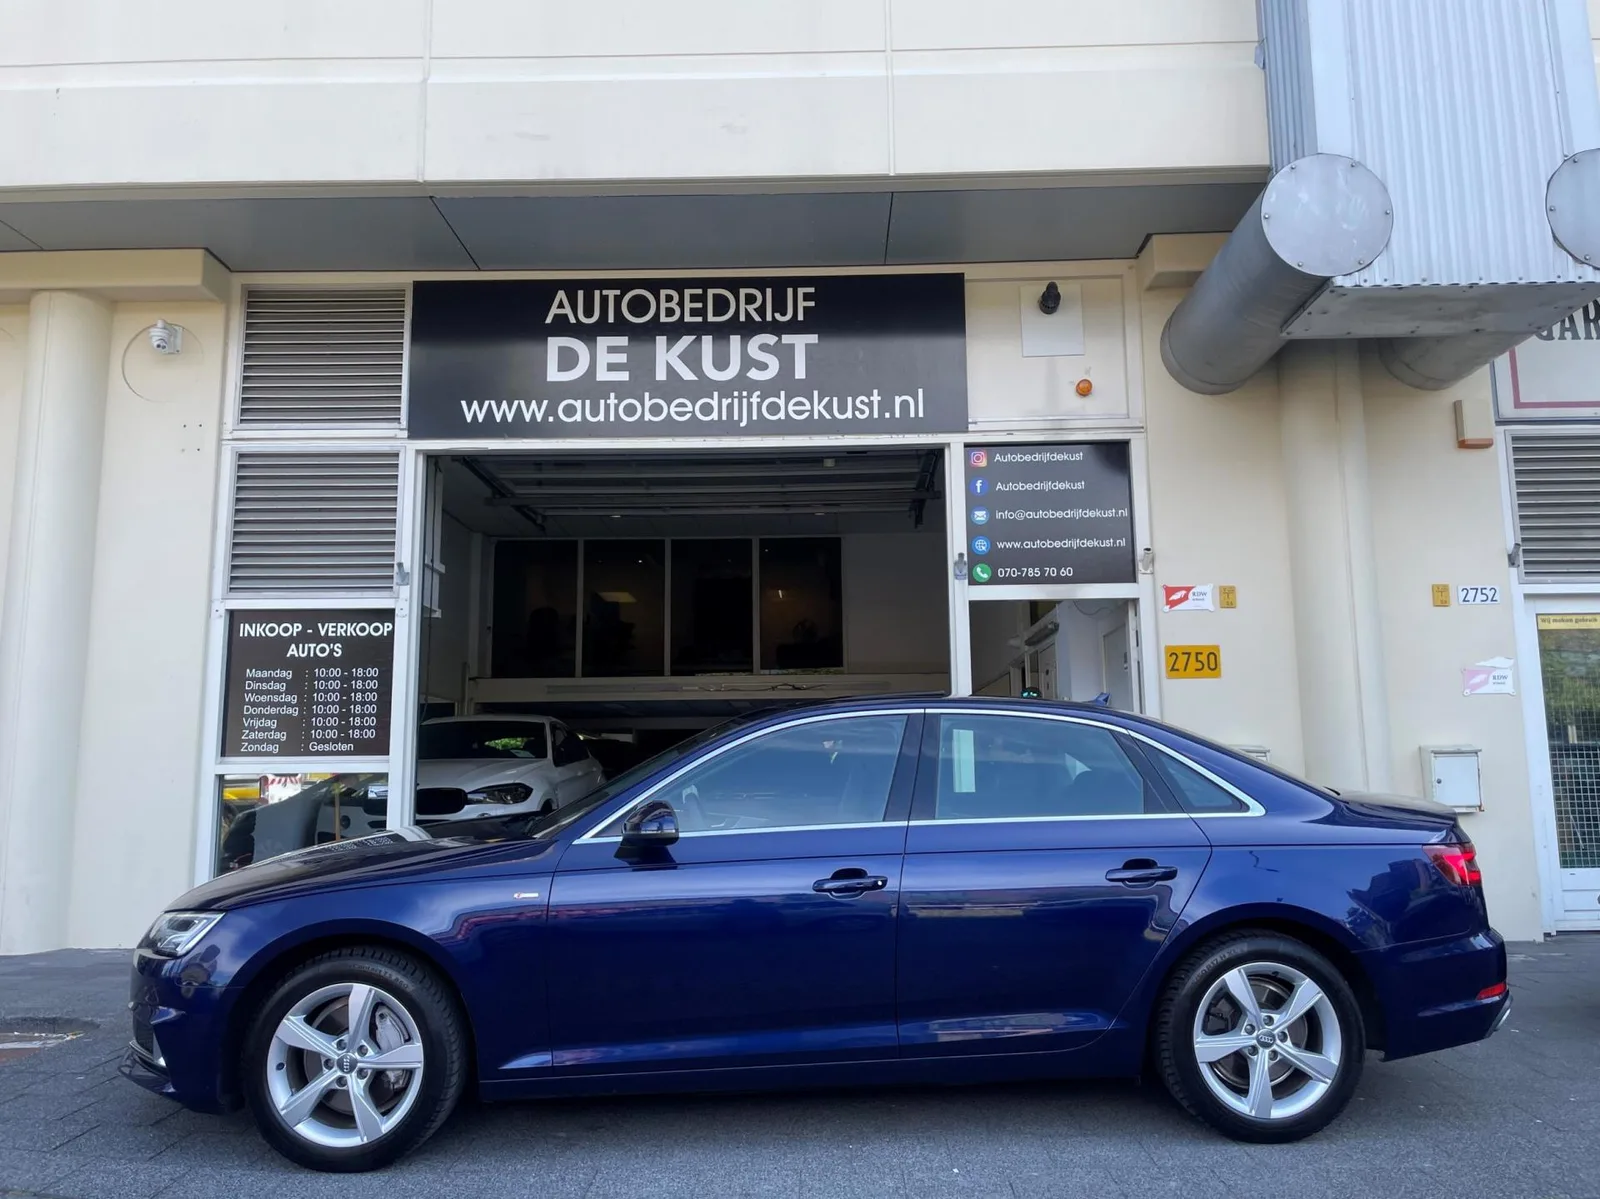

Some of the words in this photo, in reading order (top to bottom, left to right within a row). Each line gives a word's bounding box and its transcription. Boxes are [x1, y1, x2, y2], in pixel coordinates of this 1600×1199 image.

[545, 288, 815, 324] AUTOBEDRIJF
[1535, 298, 1600, 341] AR
[547, 336, 630, 382] DE
[654, 334, 819, 381] KUST
[461, 388, 924, 427] www.autobedrijfdekust.nl
[994, 452, 1083, 462] Autobedrijfdekust
[996, 481, 1084, 491] Autobedrijfdekust
[996, 508, 1127, 520] info@autobedrijfdekust.nl
[997, 538, 1125, 549] www.autobedrijfdekust.nl
[998, 568, 1040, 577] 070-785
[1044, 568, 1056, 576] 70
[1060, 567, 1073, 576] 60
[1461, 588, 1497, 602] 2752
[240, 623, 302, 637] INKOOP
[318, 623, 392, 636] VERKOOP
[287, 643, 342, 657] AUTO'S
[1169, 652, 1217, 672] 2750
[246, 669, 292, 679] Maandag
[314, 668, 341, 677] 10:00
[352, 668, 378, 677] 18:00
[246, 681, 286, 692] Dinsdag
[314, 680, 340, 689] 10:00
[351, 680, 378, 689] 18:00
[245, 693, 297, 704] Woensdag
[313, 692, 340, 701] 10:00
[351, 692, 377, 701] 18:00
[244, 705, 299, 717] Donderdag
[312, 705, 339, 714] 10:00
[350, 704, 376, 714] 18:00
[243, 718, 277, 729] Vrijdag
[312, 717, 338, 726] 10:00
[349, 717, 376, 726] 18:00
[242, 730, 287, 741] Zaterdag
[311, 729, 337, 738] 10:00
[349, 729, 375, 738] 18:00
[241, 742, 279, 753] Zondag
[309, 742, 353, 751] Gesloten
